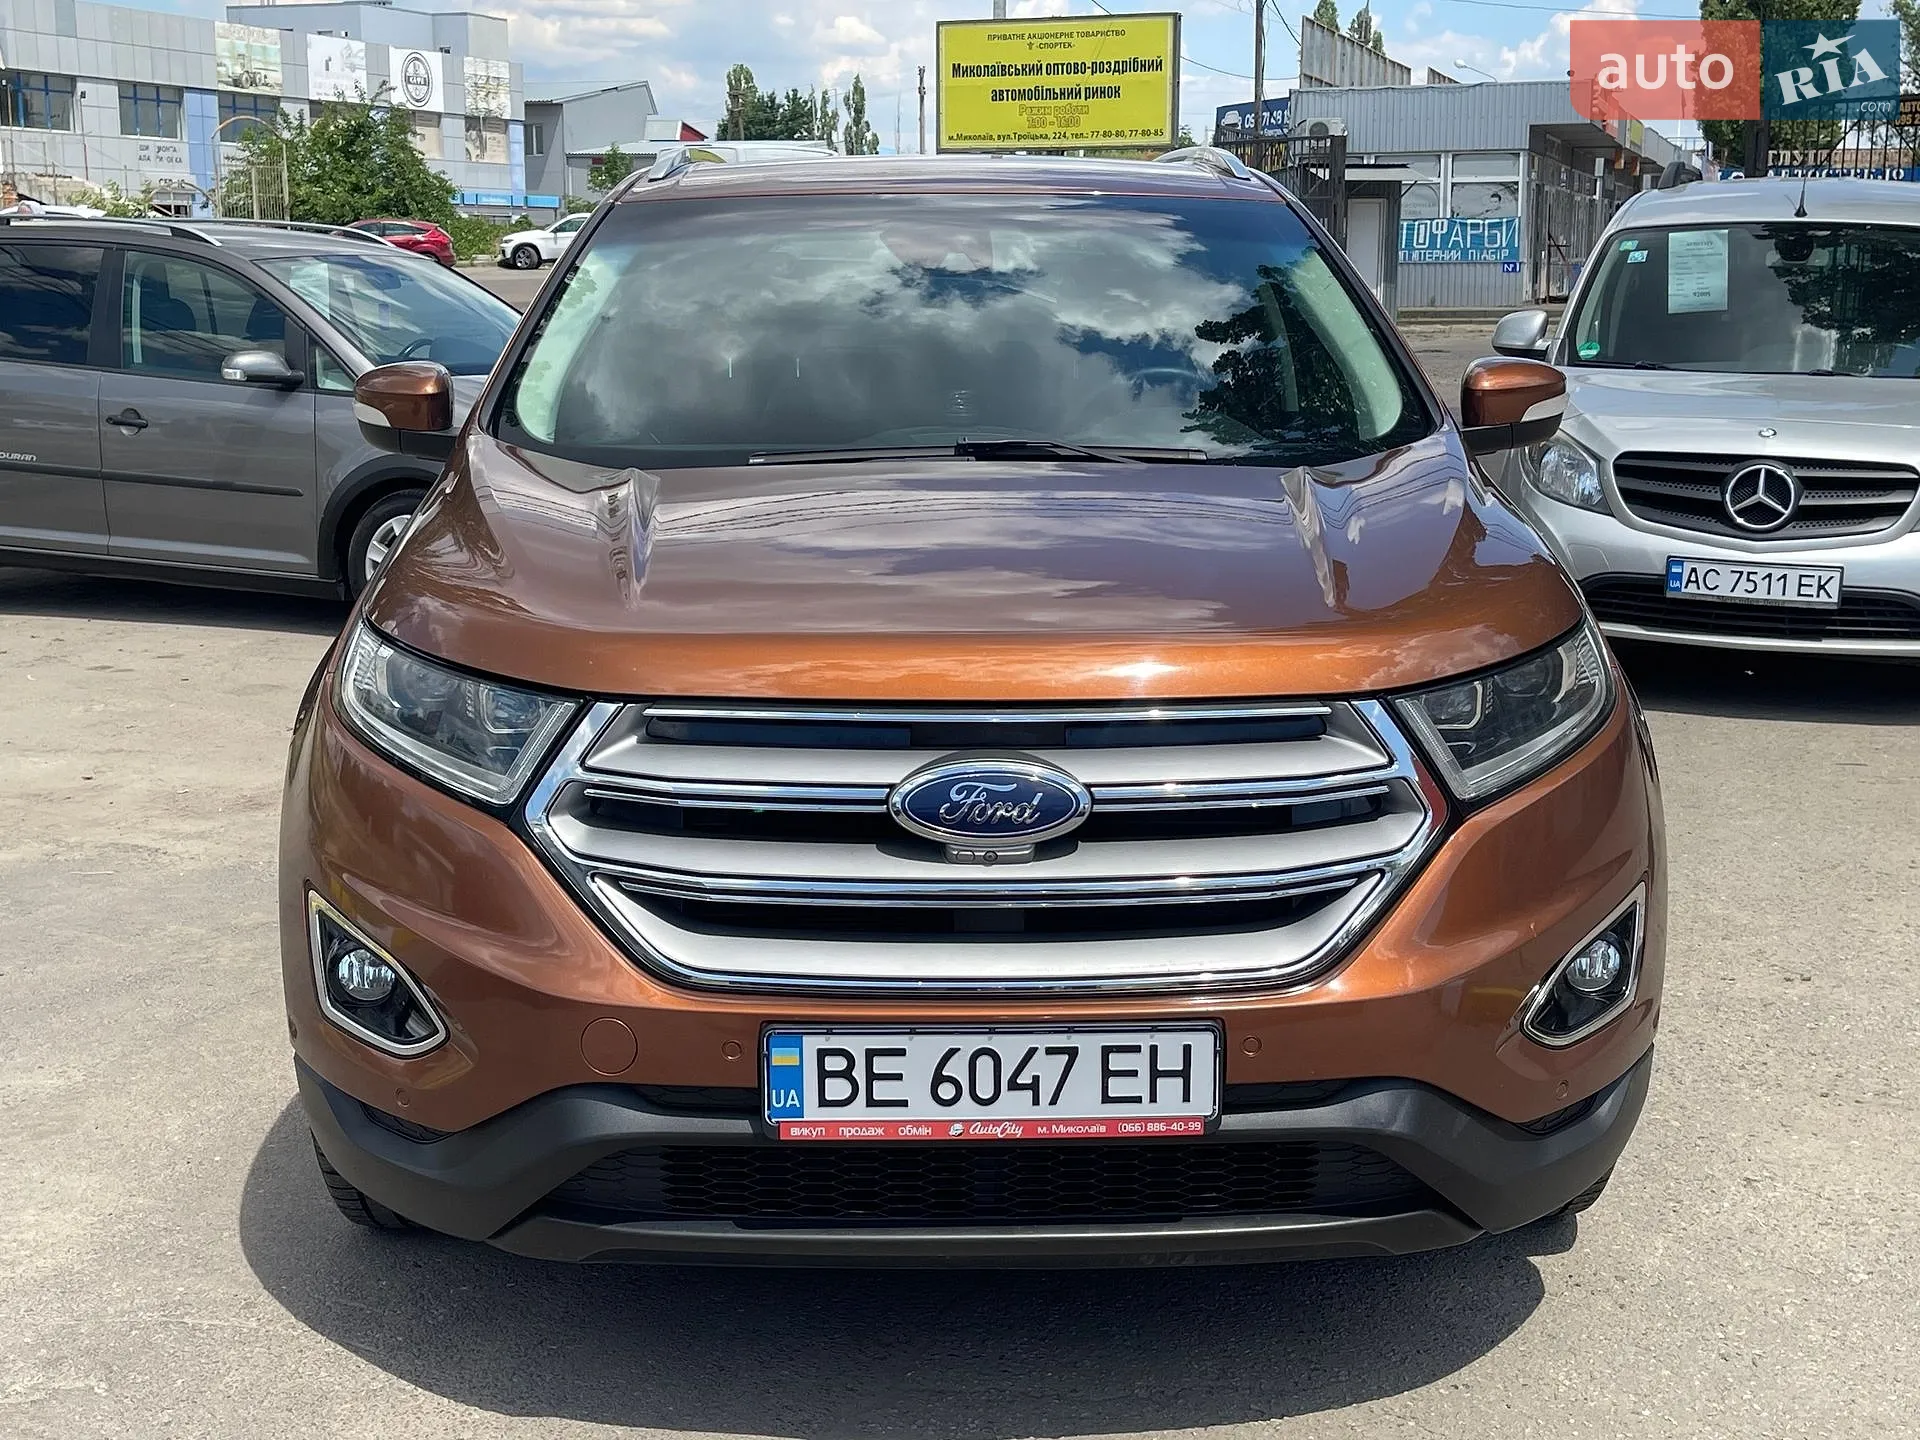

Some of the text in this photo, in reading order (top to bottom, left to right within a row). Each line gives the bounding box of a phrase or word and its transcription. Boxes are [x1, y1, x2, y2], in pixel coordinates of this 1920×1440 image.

[987, 29, 1126, 41] ПРИВАТНЕ АКЦІОНЕРНЕ ТОВАРИСТВО
[952, 56, 1163, 78] Миколаївський оптово-роздрібний
[991, 85, 1121, 102] автомобільний ринок
[1054, 103, 1089, 117] роботи
[1128, 129, 1164, 137] 77-80-85
[1670, 567, 1836, 599] UA AC 7511 EK
[939, 781, 1043, 825] Ford
[772, 1043, 1192, 1108] UA BE 6047 EH
[790, 1124, 932, 1138] викуп продаж обмін
[969, 1121, 1024, 1138] AutoCity
[1037, 1123, 1107, 1134] м. Миколаїв
[1118, 1121, 1202, 1133] (066) 886-40-99
